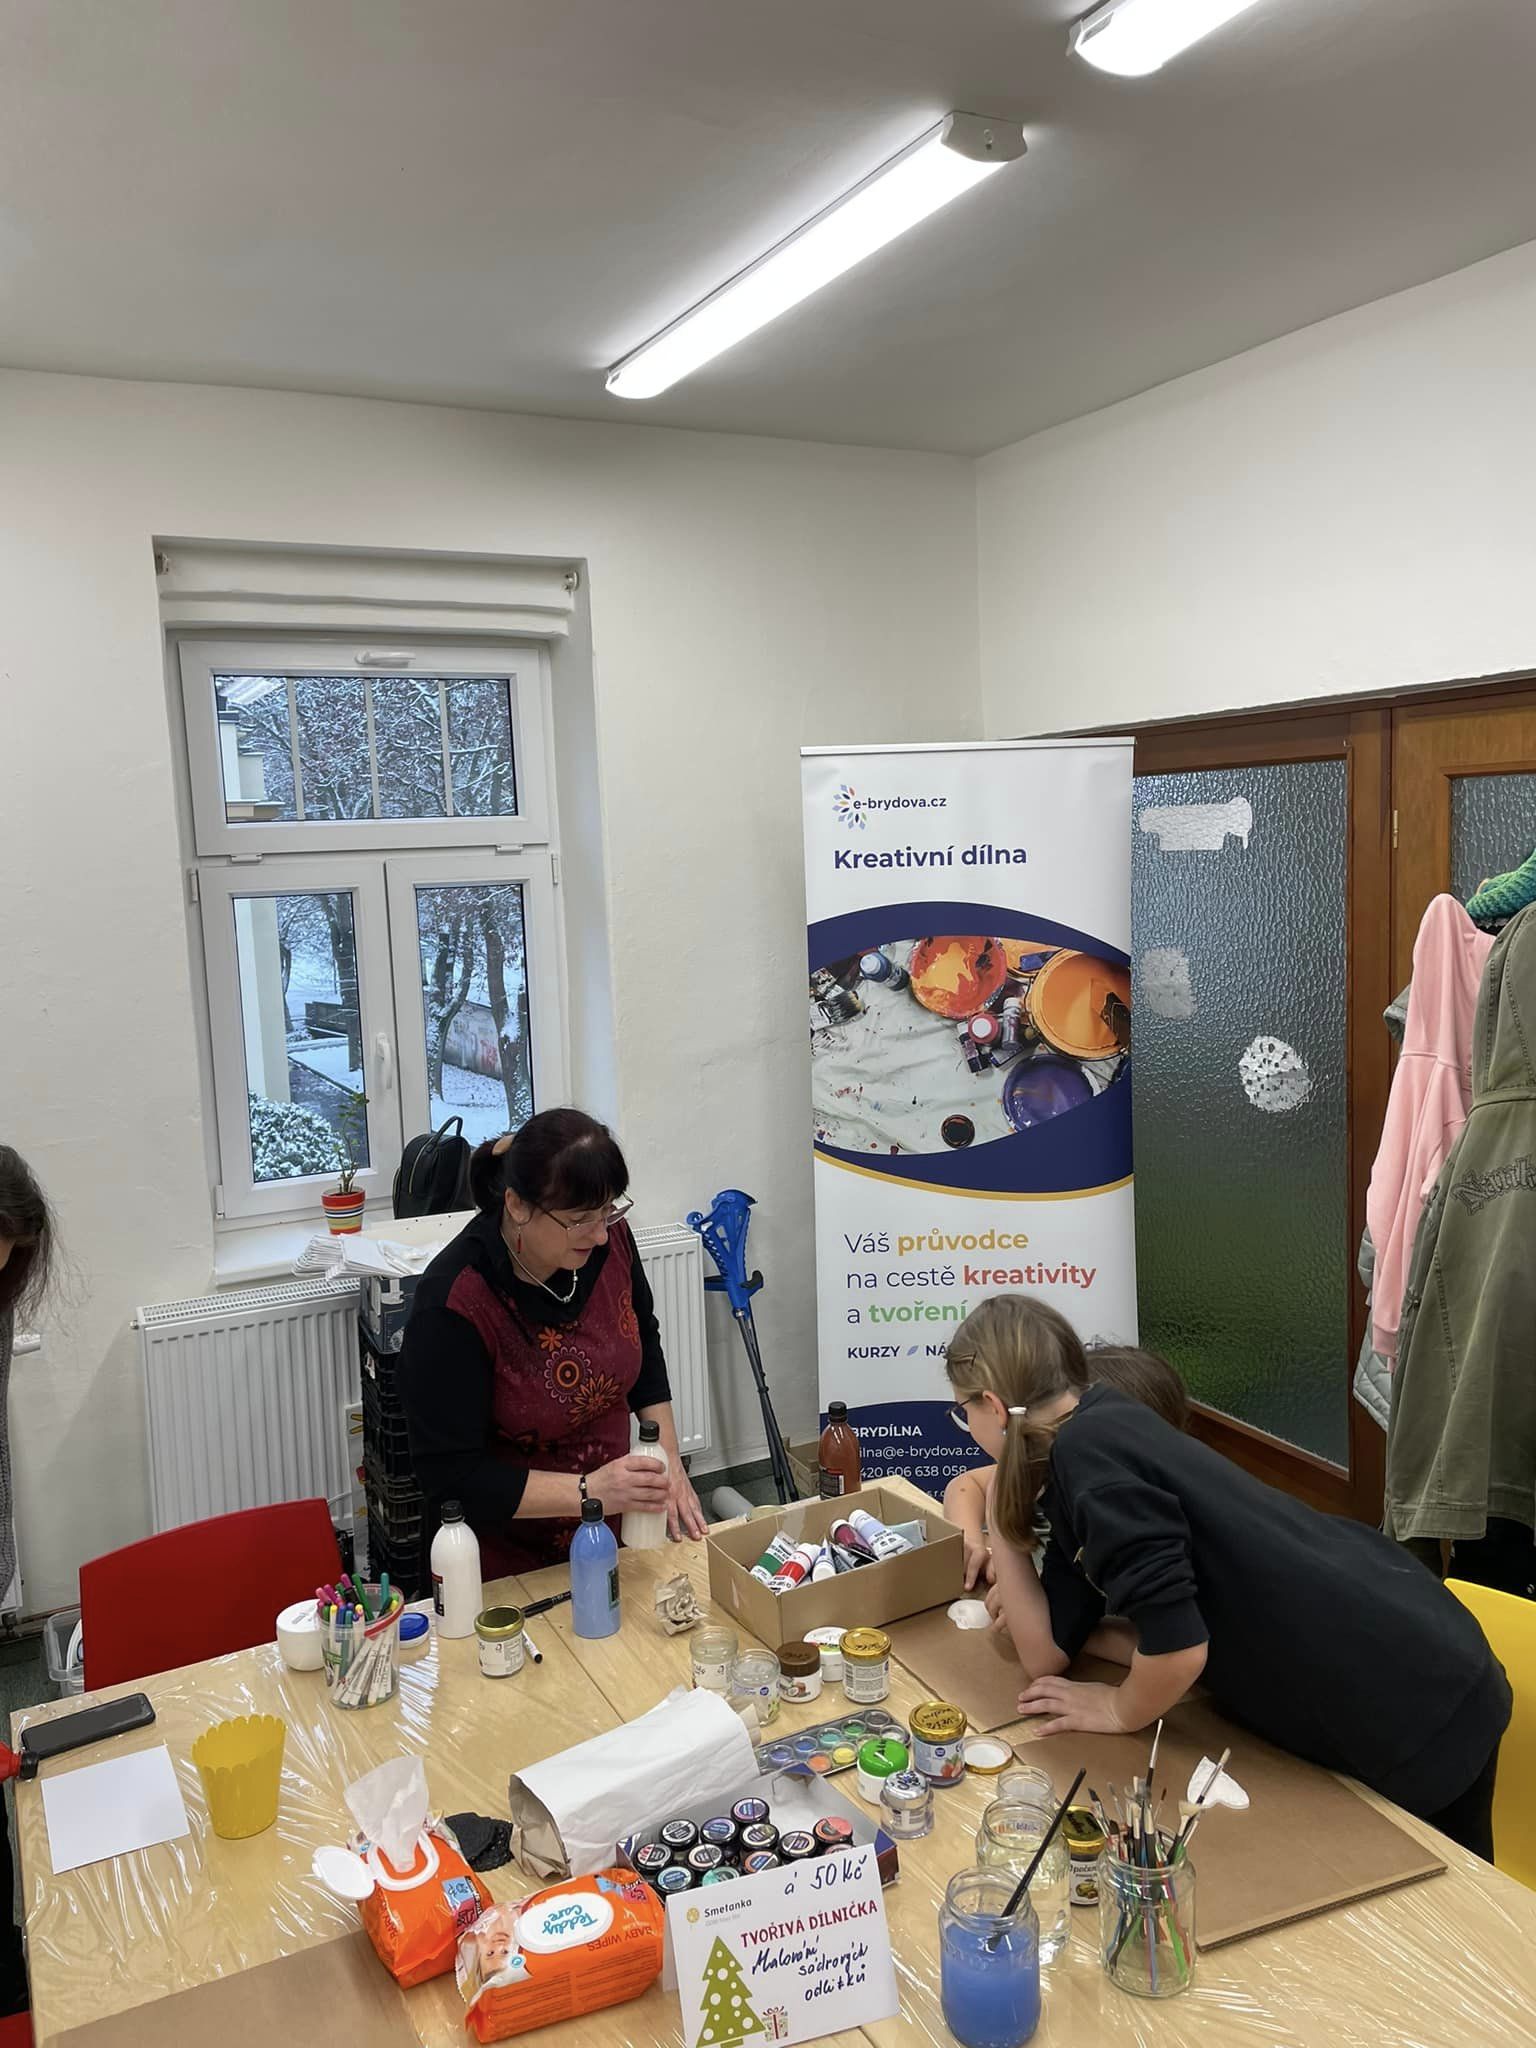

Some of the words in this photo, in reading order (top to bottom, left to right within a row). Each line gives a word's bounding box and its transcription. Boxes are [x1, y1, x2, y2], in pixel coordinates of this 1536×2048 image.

[853, 796, 947, 811] e-brydova.cz
[834, 846, 954, 869] Kreativní
[961, 844, 1027, 865] dílna
[844, 1232, 890, 1254] Váš
[898, 1228, 1029, 1257] průvodce
[847, 1272, 877, 1289] na
[886, 1265, 956, 1287] cestě
[963, 1262, 1097, 1289] kreativity
[847, 1308, 860, 1324] a
[868, 1300, 968, 1323] tvoření
[847, 1345, 901, 1359] KURZY
[859, 1445, 980, 1460] ilna@e-brydova.cz
[861, 1466, 884, 1479] 420
[886, 1466, 912, 1477] 606
[915, 1465, 939, 1477] 638
[810, 1863, 837, 1890] 50
[842, 1854, 868, 1883] Kč
[704, 1898, 752, 1918] Smetanka
[541, 1911, 598, 1935] Teddy
[740, 1915, 805, 1948] TVOŘIVÁ
[808, 1900, 878, 1930] DÍLNIČKA
[587, 1936, 622, 1952] WIPES
